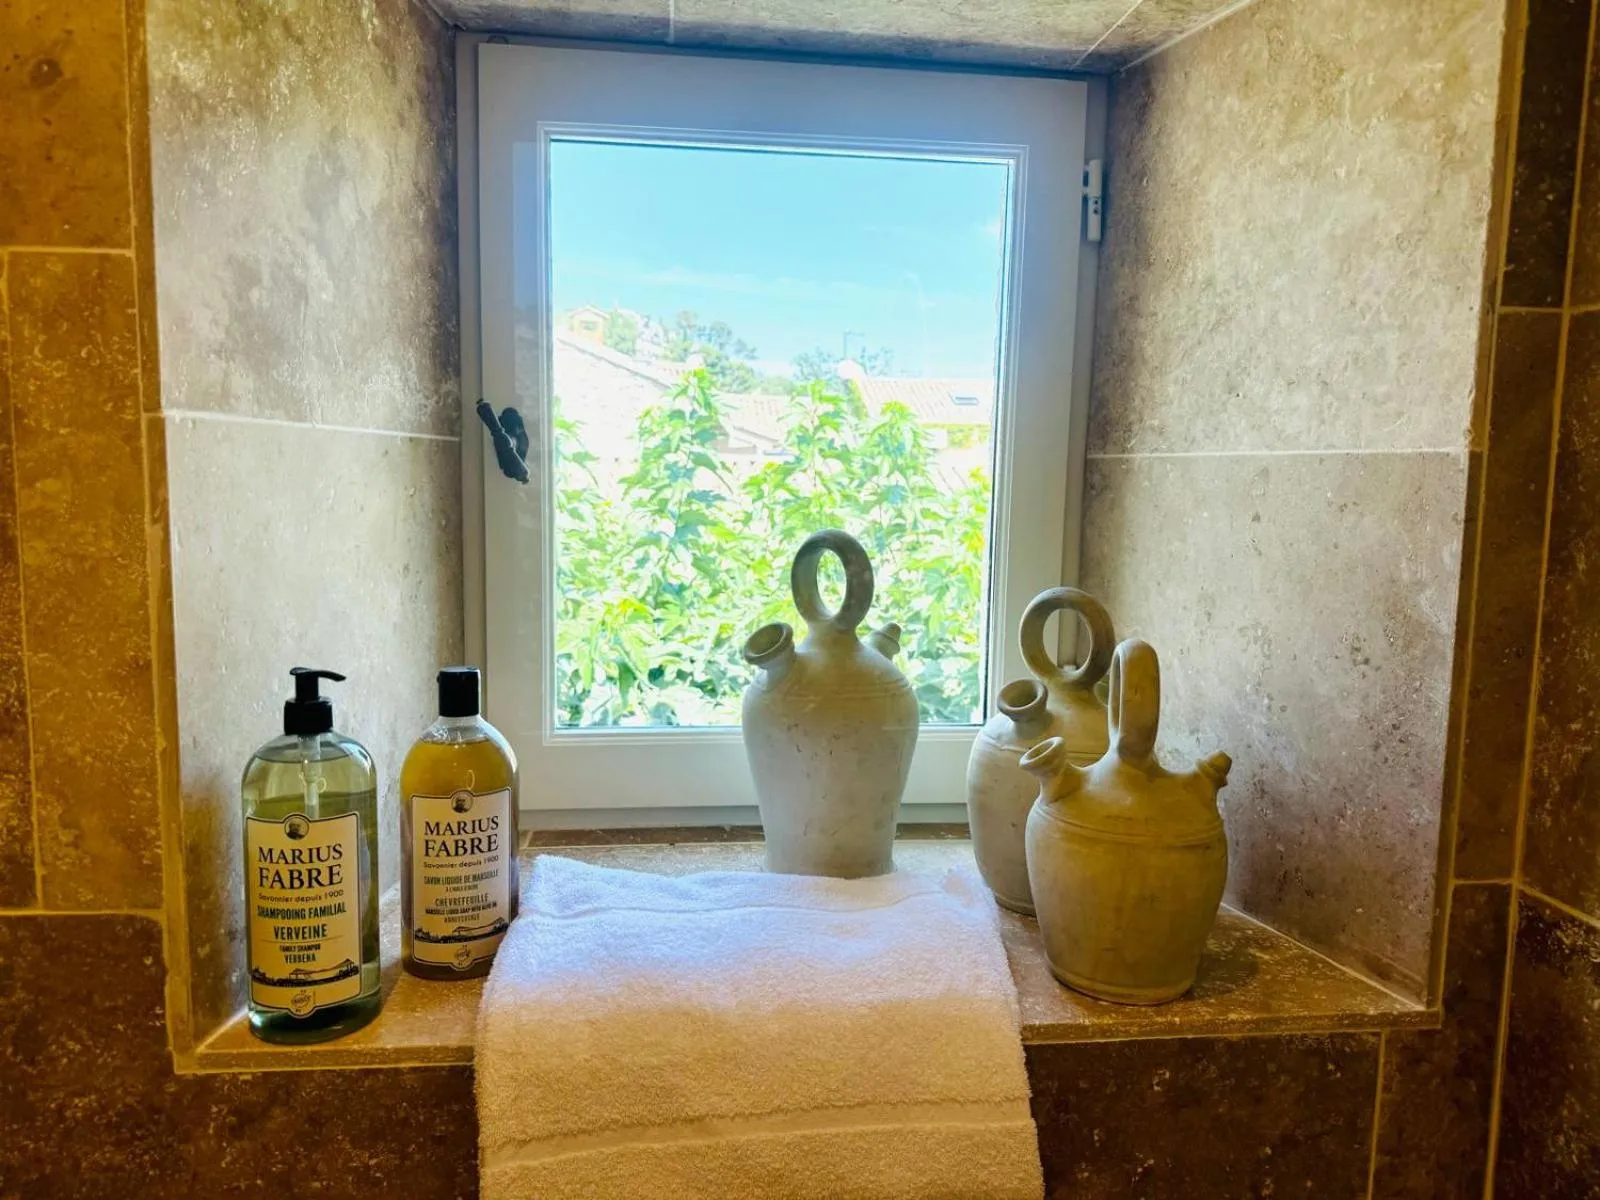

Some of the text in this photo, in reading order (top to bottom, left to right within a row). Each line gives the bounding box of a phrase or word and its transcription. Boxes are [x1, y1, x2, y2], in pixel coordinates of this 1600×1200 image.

[424, 815, 499, 836] MARIUS
[258, 843, 343, 865] MARIUS
[424, 834, 499, 858] FABRE
[424, 861, 457, 870] Savonnier
[459, 859, 482, 870] depuis
[258, 864, 343, 890] FABRE
[258, 889, 344, 904] Savonnier depuis 1900
[257, 902, 346, 920] SHAMPOOING FAMILIAL
[273, 923, 328, 941] VERVEINE
[284, 952, 316, 964] VERBENA
